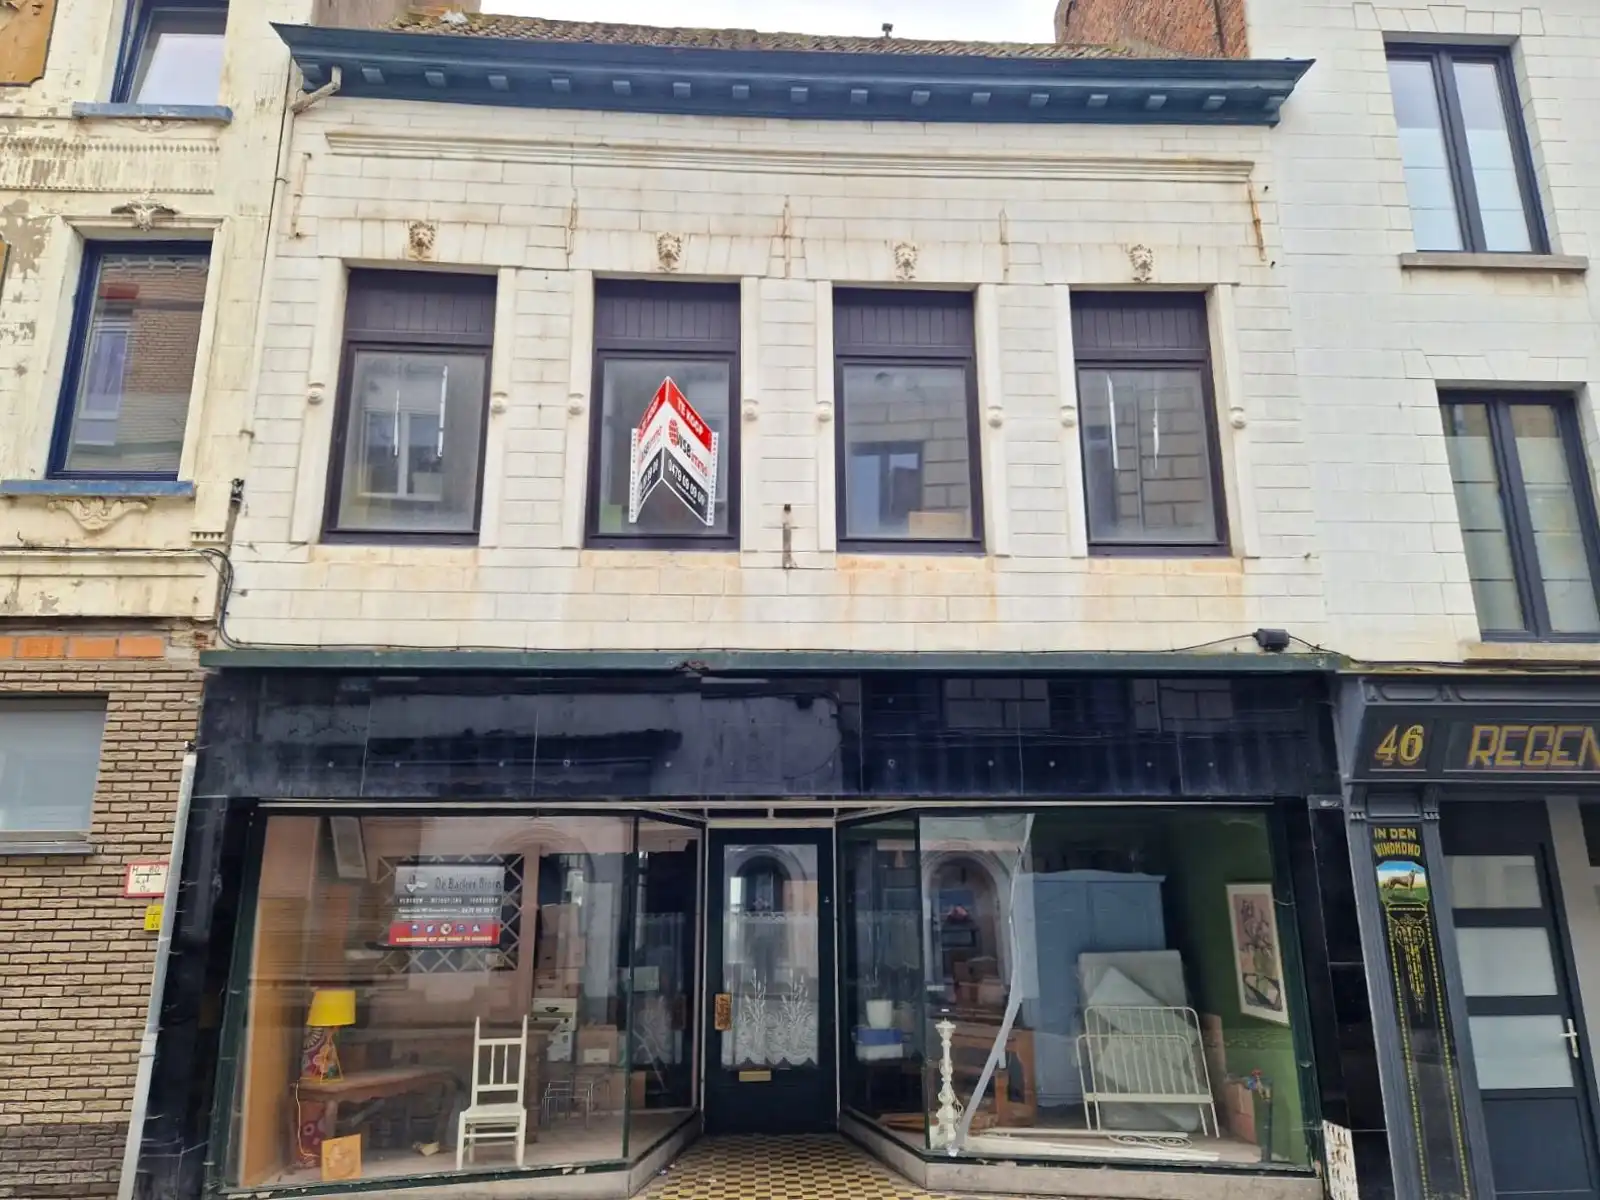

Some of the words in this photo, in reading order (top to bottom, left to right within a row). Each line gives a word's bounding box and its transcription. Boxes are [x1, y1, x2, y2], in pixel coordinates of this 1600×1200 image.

[1374, 723, 1424, 766] 46
[1373, 827, 1387, 838] IN
[1389, 827, 1417, 840] DEN
